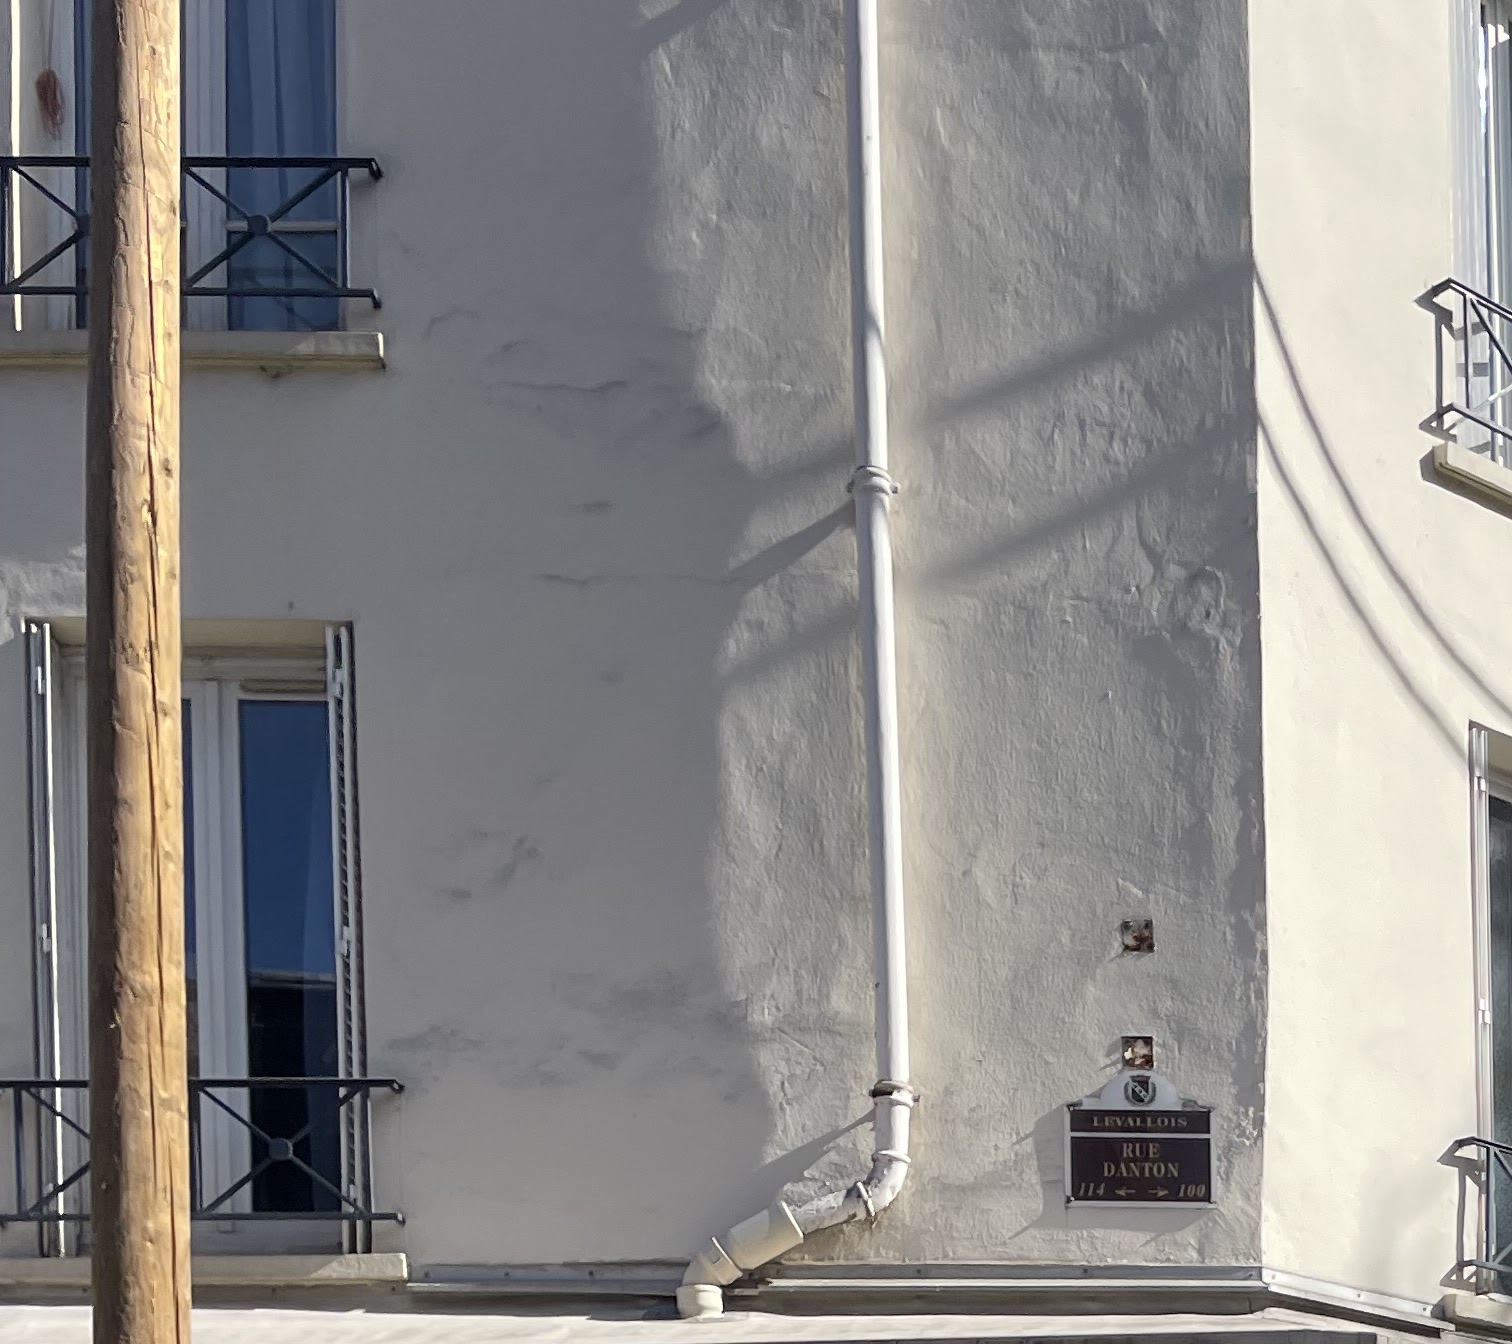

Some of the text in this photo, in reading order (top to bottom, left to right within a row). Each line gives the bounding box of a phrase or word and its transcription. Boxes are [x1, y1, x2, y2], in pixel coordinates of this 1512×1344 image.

[1092, 1116, 1188, 1128] LEVALLOIS
[1122, 1142, 1160, 1158] RUE
[1103, 1161, 1179, 1178] DANTON
[1078, 1182, 1206, 1198] 114 100
